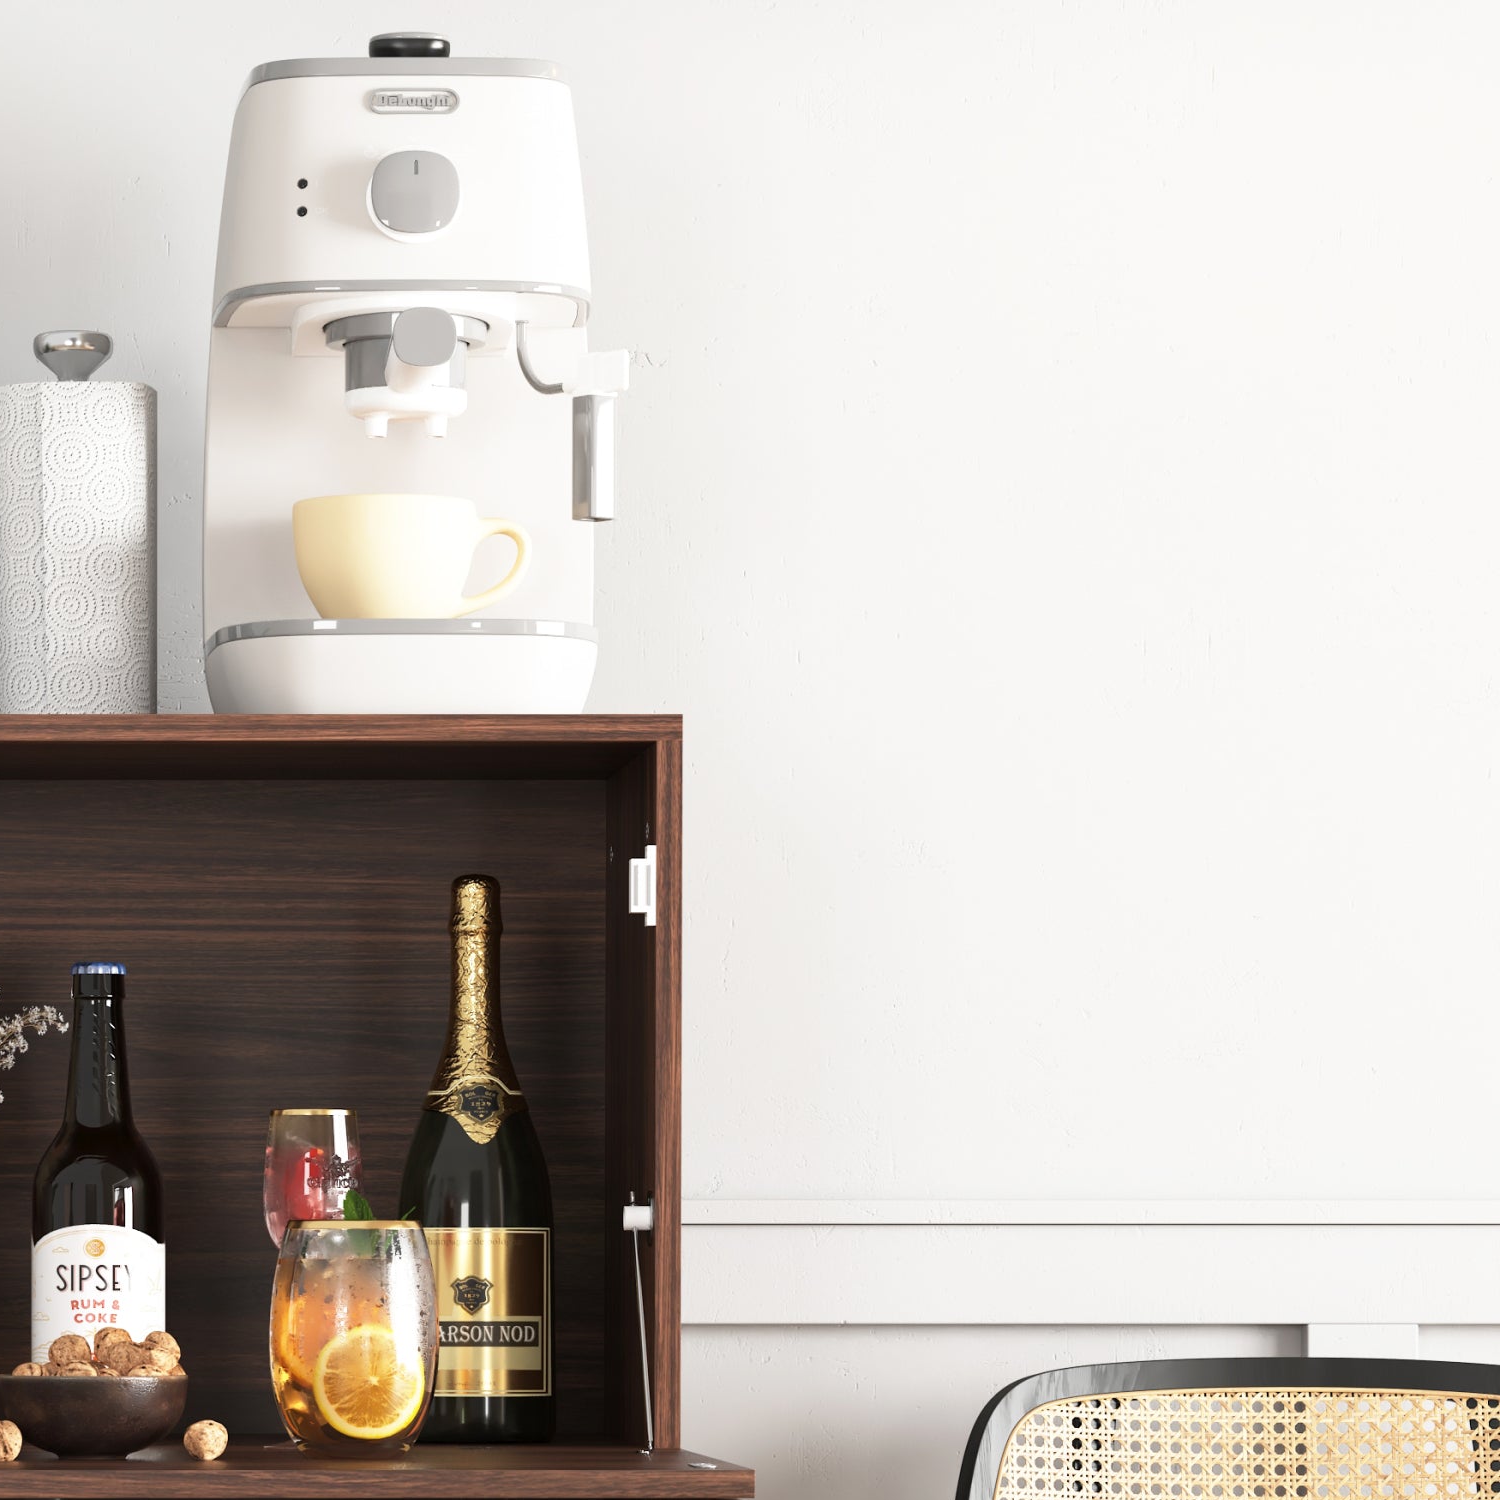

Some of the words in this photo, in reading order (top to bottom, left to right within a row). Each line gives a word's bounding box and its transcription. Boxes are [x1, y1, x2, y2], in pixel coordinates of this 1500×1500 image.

[56, 1265, 131, 1291] SIPSEY
[71, 1299, 105, 1310] RUM
[112, 1300, 120, 1310] &
[74, 1314, 118, 1323] COKE
[499, 1325, 535, 1342] NOD
